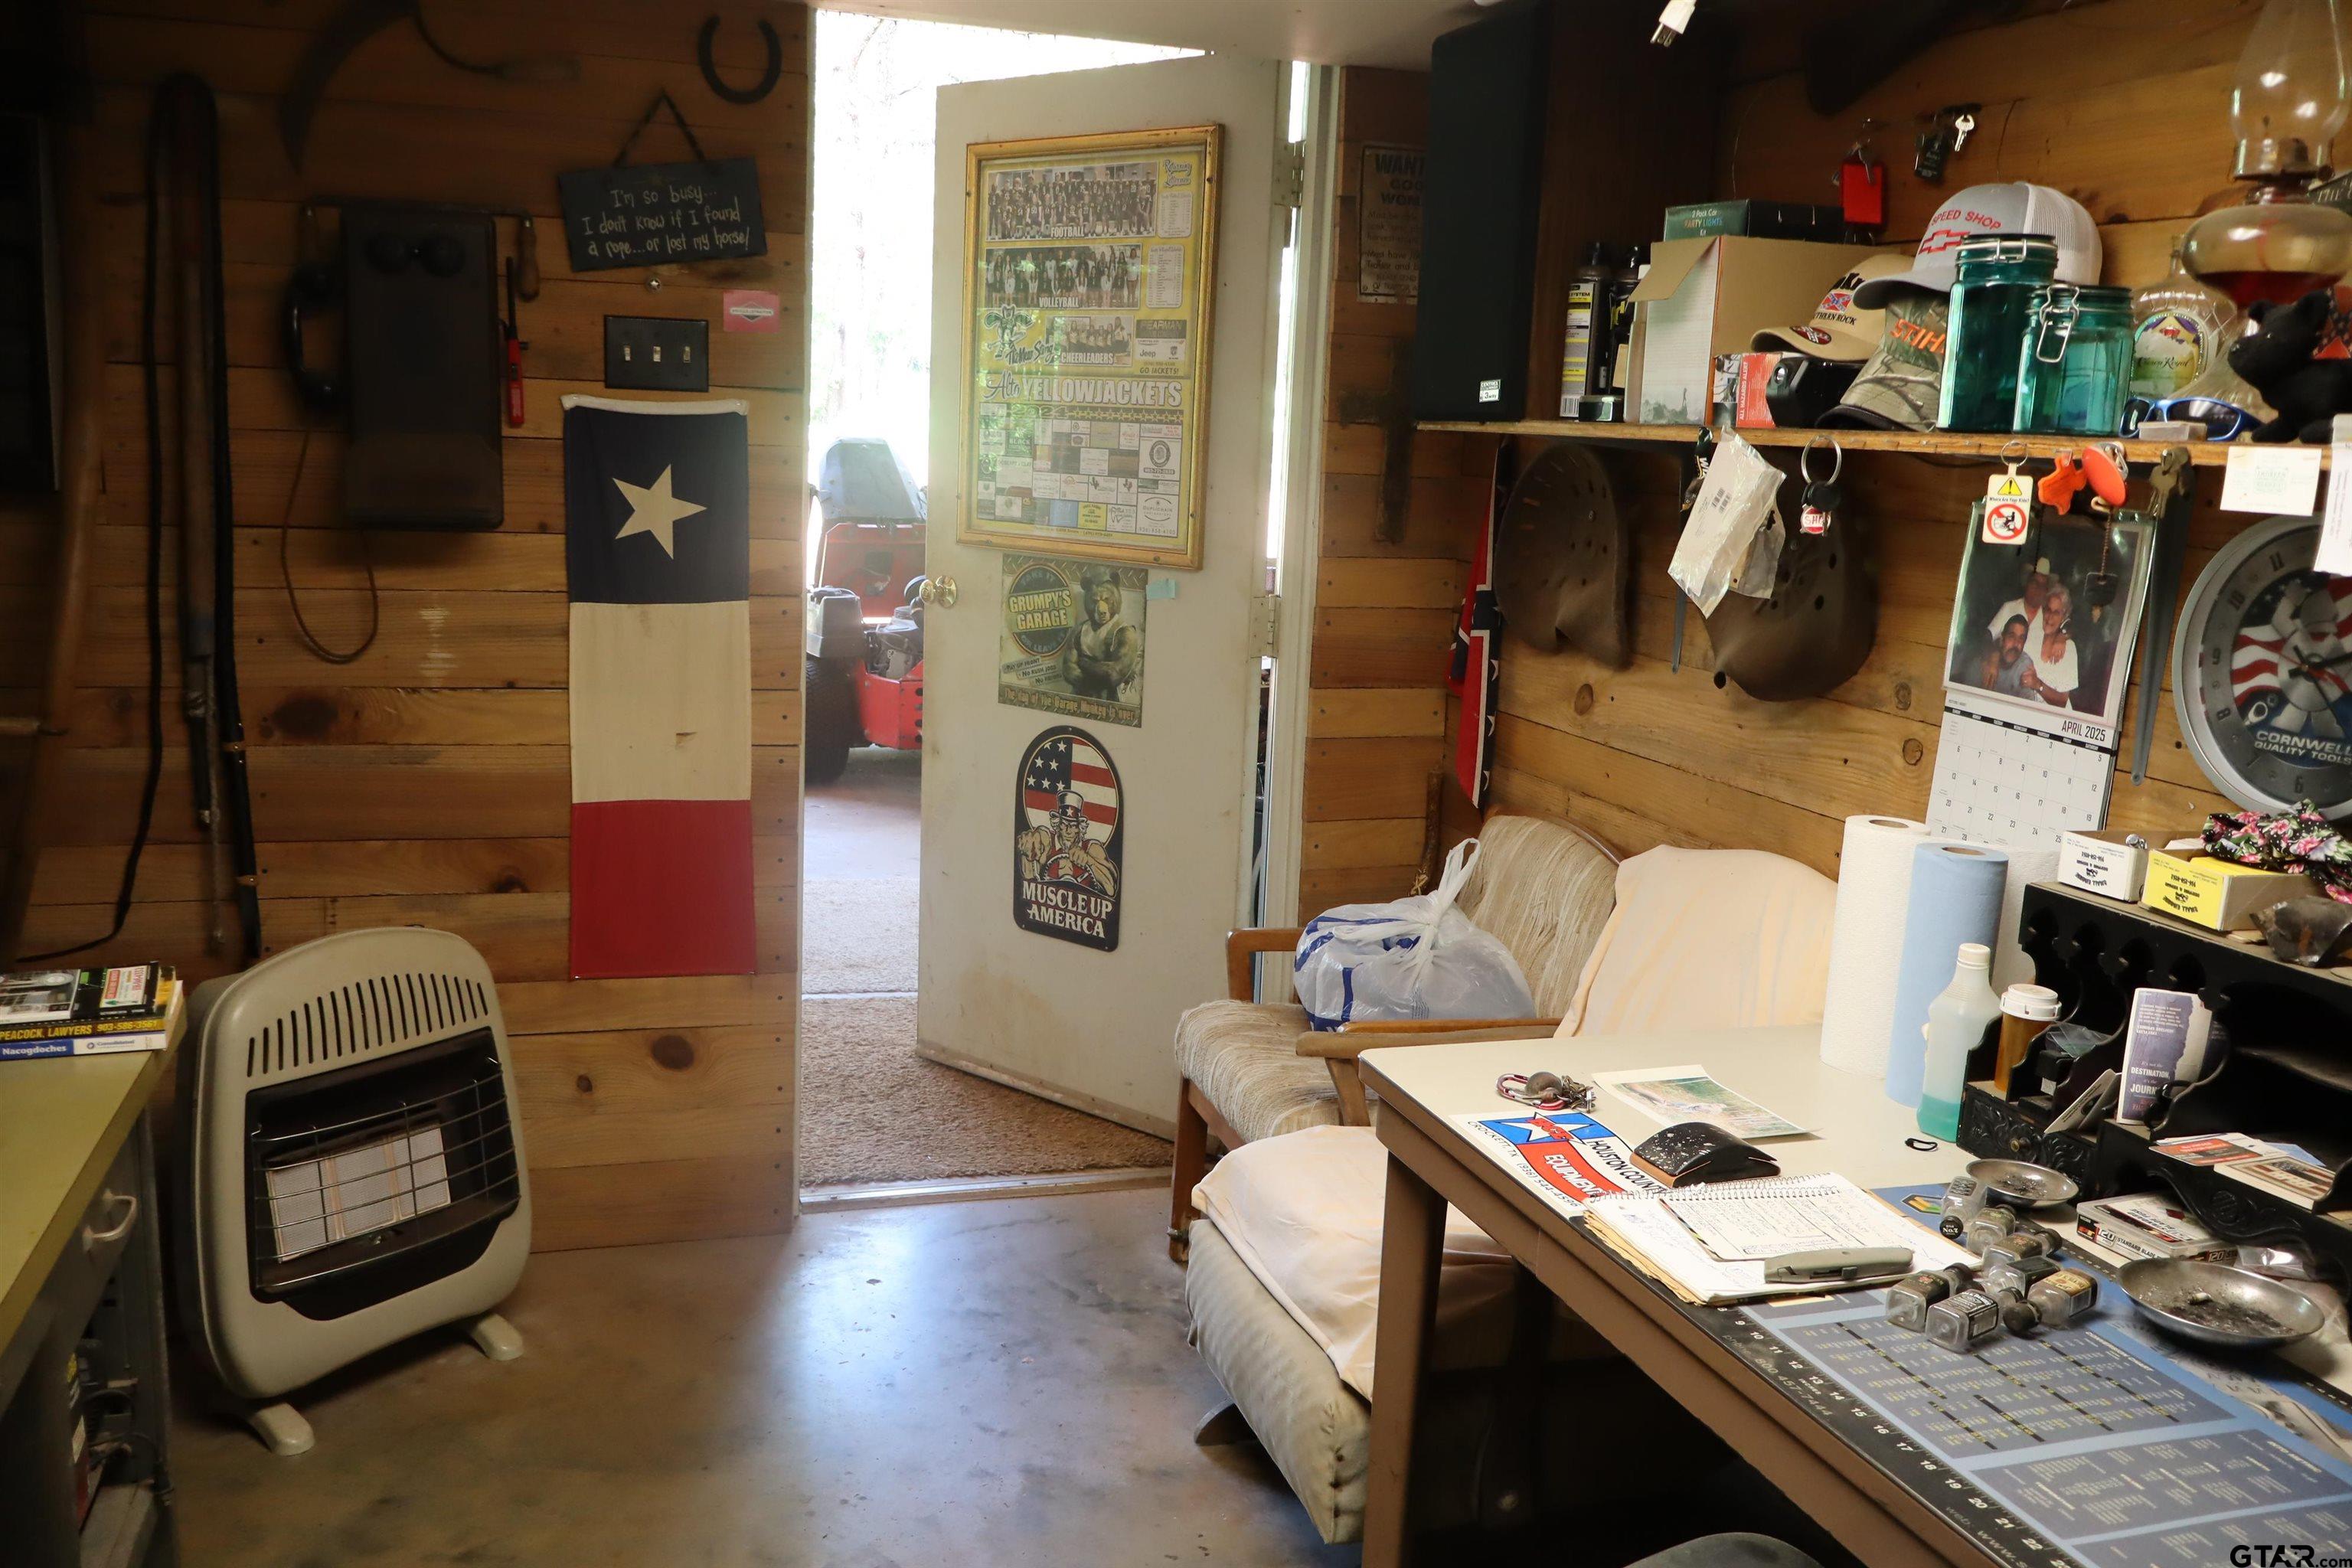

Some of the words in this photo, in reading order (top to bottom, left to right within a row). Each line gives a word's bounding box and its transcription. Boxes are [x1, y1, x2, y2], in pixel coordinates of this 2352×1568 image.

[611, 188, 635, 207] I'm
[643, 191, 658, 204] so
[582, 217, 593, 235] I
[671, 211, 683, 228] if
[688, 210, 700, 227] I
[704, 196, 740, 224] found
[1684, 219, 1702, 228] PARTY
[1932, 210, 1961, 226] SPEED
[1965, 211, 2001, 230] SHOP
[1050, 226, 1085, 238] FOOTBALL
[588, 241, 599, 256] a
[667, 234, 687, 254] lost
[694, 236, 710, 251] my
[1039, 296, 1079, 309] VOLLEYBALL
[1836, 312, 1857, 326] ROCK
[1890, 318, 1945, 354] STIH
[1060, 352, 1114, 364] CHEERLEADERS
[1140, 350, 1156, 358] Jeep
[983, 370, 1021, 400] Alto
[1022, 379, 1182, 408] YELLOWJACKETS
[2269, 551, 2285, 572] 11
[1009, 590, 1071, 613] GRUMPY'S
[2227, 590, 2246, 612] 10
[1017, 609, 1068, 630] GARAGE
[2216, 707, 2233, 720] 8
[2061, 720, 2082, 737] APRIL
[2085, 725, 2106, 743] 2025
[2048, 741, 2053, 750] 3
[2072, 747, 2077, 756] 4
[2097, 754, 2102, 763] 5
[2254, 740, 2306, 757] QUALITY
[2311, 750, 2352, 766] TOOLS
[2255, 730, 2352, 757] CORNWELL
[2042, 770, 2048, 779] 10
[2067, 777, 2072, 786] 11
[2091, 784, 2097, 792] 12
[1993, 785, 1998, 793] 15
[2015, 792, 2020, 800] 16
[2061, 806, 2066, 815] 18
[2086, 814, 2092, 822] 19
[1941, 825, 1947, 834] 27
[1962, 833, 1968, 841] 28
[2009, 820, 2016, 828] 23
[2055, 835, 2062, 843] 25
[1023, 880, 1088, 915] MUSCLE
[1089, 898, 1113, 920] UP
[1026, 903, 1106, 939] AMERICA
[48, 1024, 92, 1037] LAWYERS
[2, 1045, 67, 1056] Nacogdoches
[2131, 1067, 2170, 1080] DESTINATION,
[1468, 1121, 1511, 1148] CROCKETT,
[1505, 1148, 1519, 1158] TX
[1587, 1139, 1625, 1170] HOUSTON
[1516, 1162, 1538, 1184] (936)
[1534, 1179, 1581, 1207] 544-4596
[2099, 1227, 2115, 1242] 120
[2118, 1238, 2141, 1252] STANDARD
[2208, 1250, 2223, 1263] 120
[1755, 1358, 1779, 1374] 800
[1777, 1374, 1834, 1417] 457-7444
[1798, 1378, 1821, 1394] INCHES
[1750, 1331, 1764, 1340] 10
[1769, 1346, 1783, 1354] 11
[1788, 1361, 1803, 1370] 12
[1808, 1376, 1824, 1385] 13
[1830, 1391, 1845, 1401] 14
[1851, 1407, 1868, 1418] 15
[1873, 1425, 1890, 1436] 16
[1896, 1442, 1914, 1452] 17
[1919, 1460, 1938, 1472] 18
[1945, 1478, 1962, 1491] 19
[1968, 1497, 1988, 1509] 20
[1994, 1517, 2015, 1529] 21
[2020, 1537, 2043, 1551] 22
